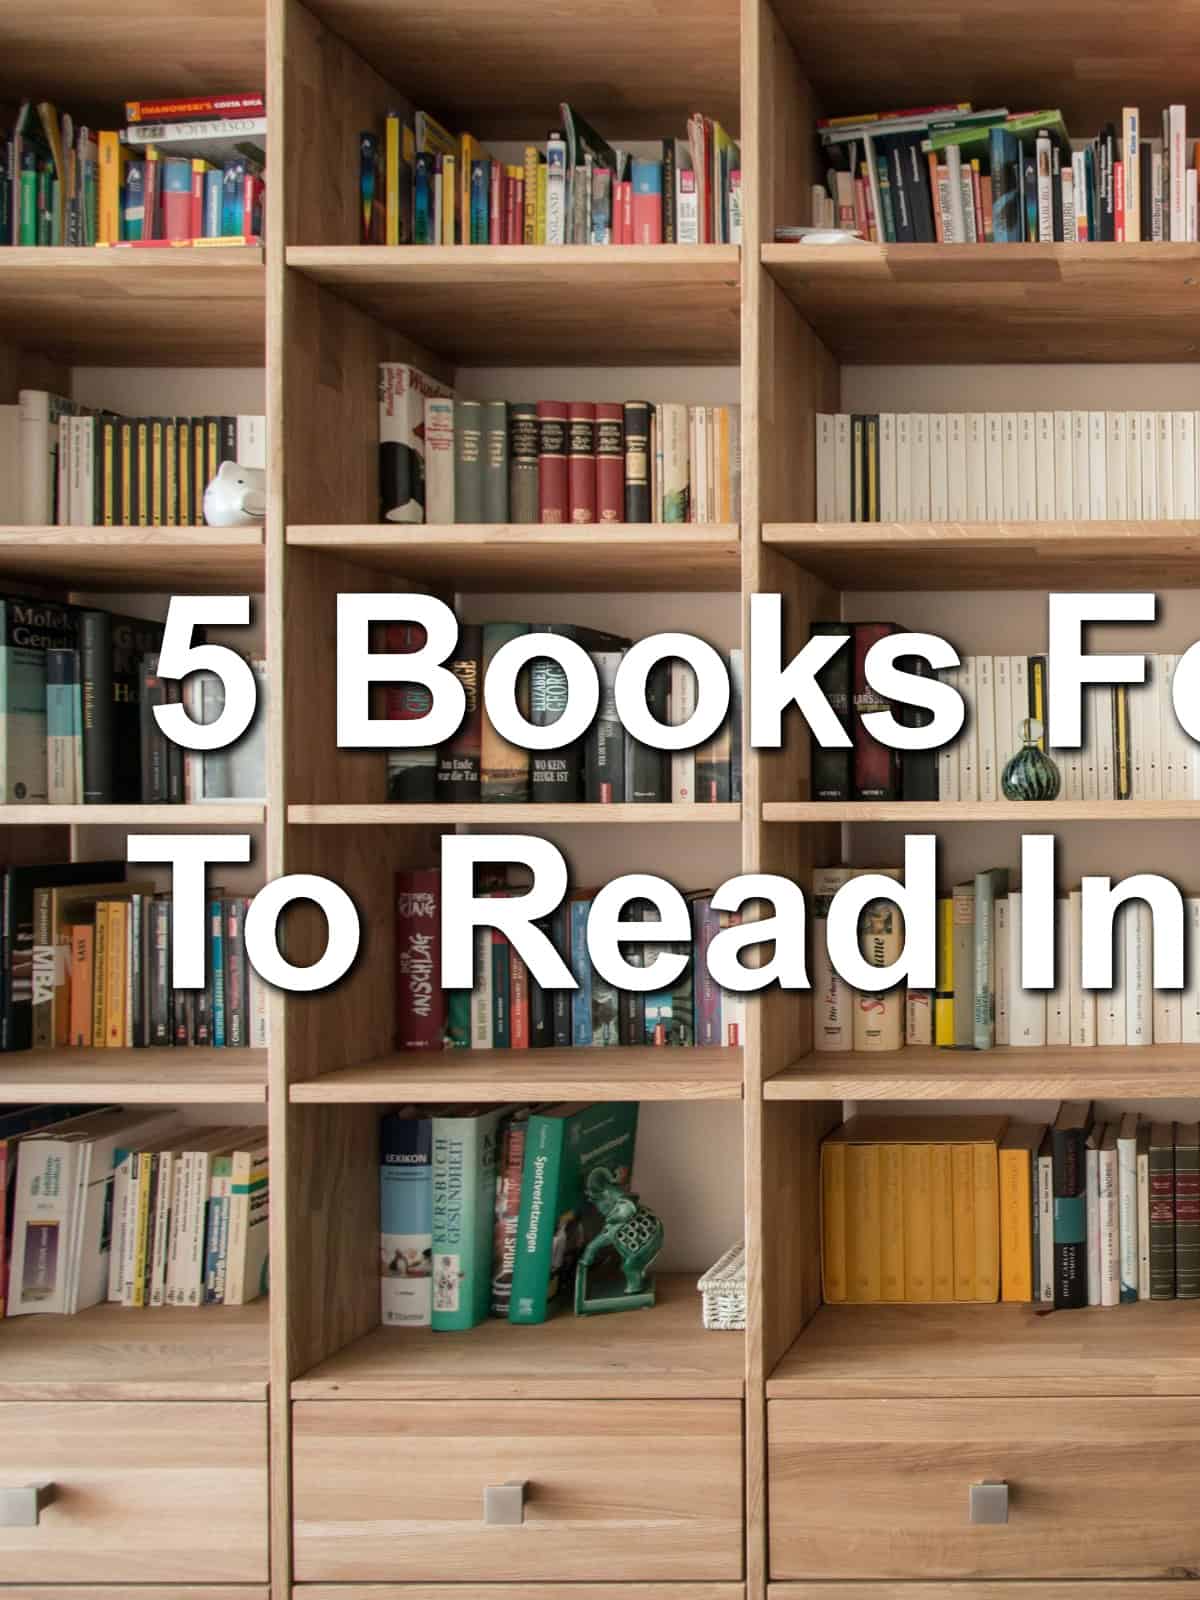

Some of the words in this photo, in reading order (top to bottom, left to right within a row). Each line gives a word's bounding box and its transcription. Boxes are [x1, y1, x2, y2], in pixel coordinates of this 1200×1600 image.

[548, 192, 560, 243] NGLAND
[852, 693, 886, 705] LARSS
[548, 759, 567, 770] KEIN
[33, 945, 57, 1006] MBA
[408, 932, 436, 1017] ANSCHLAG
[385, 1153, 428, 1163] LEXIKON
[433, 1138, 448, 1244] KURSBUCH
[447, 1137, 464, 1246] GESUNDHEIT
[525, 1154, 549, 1253] Sportverletzungen
